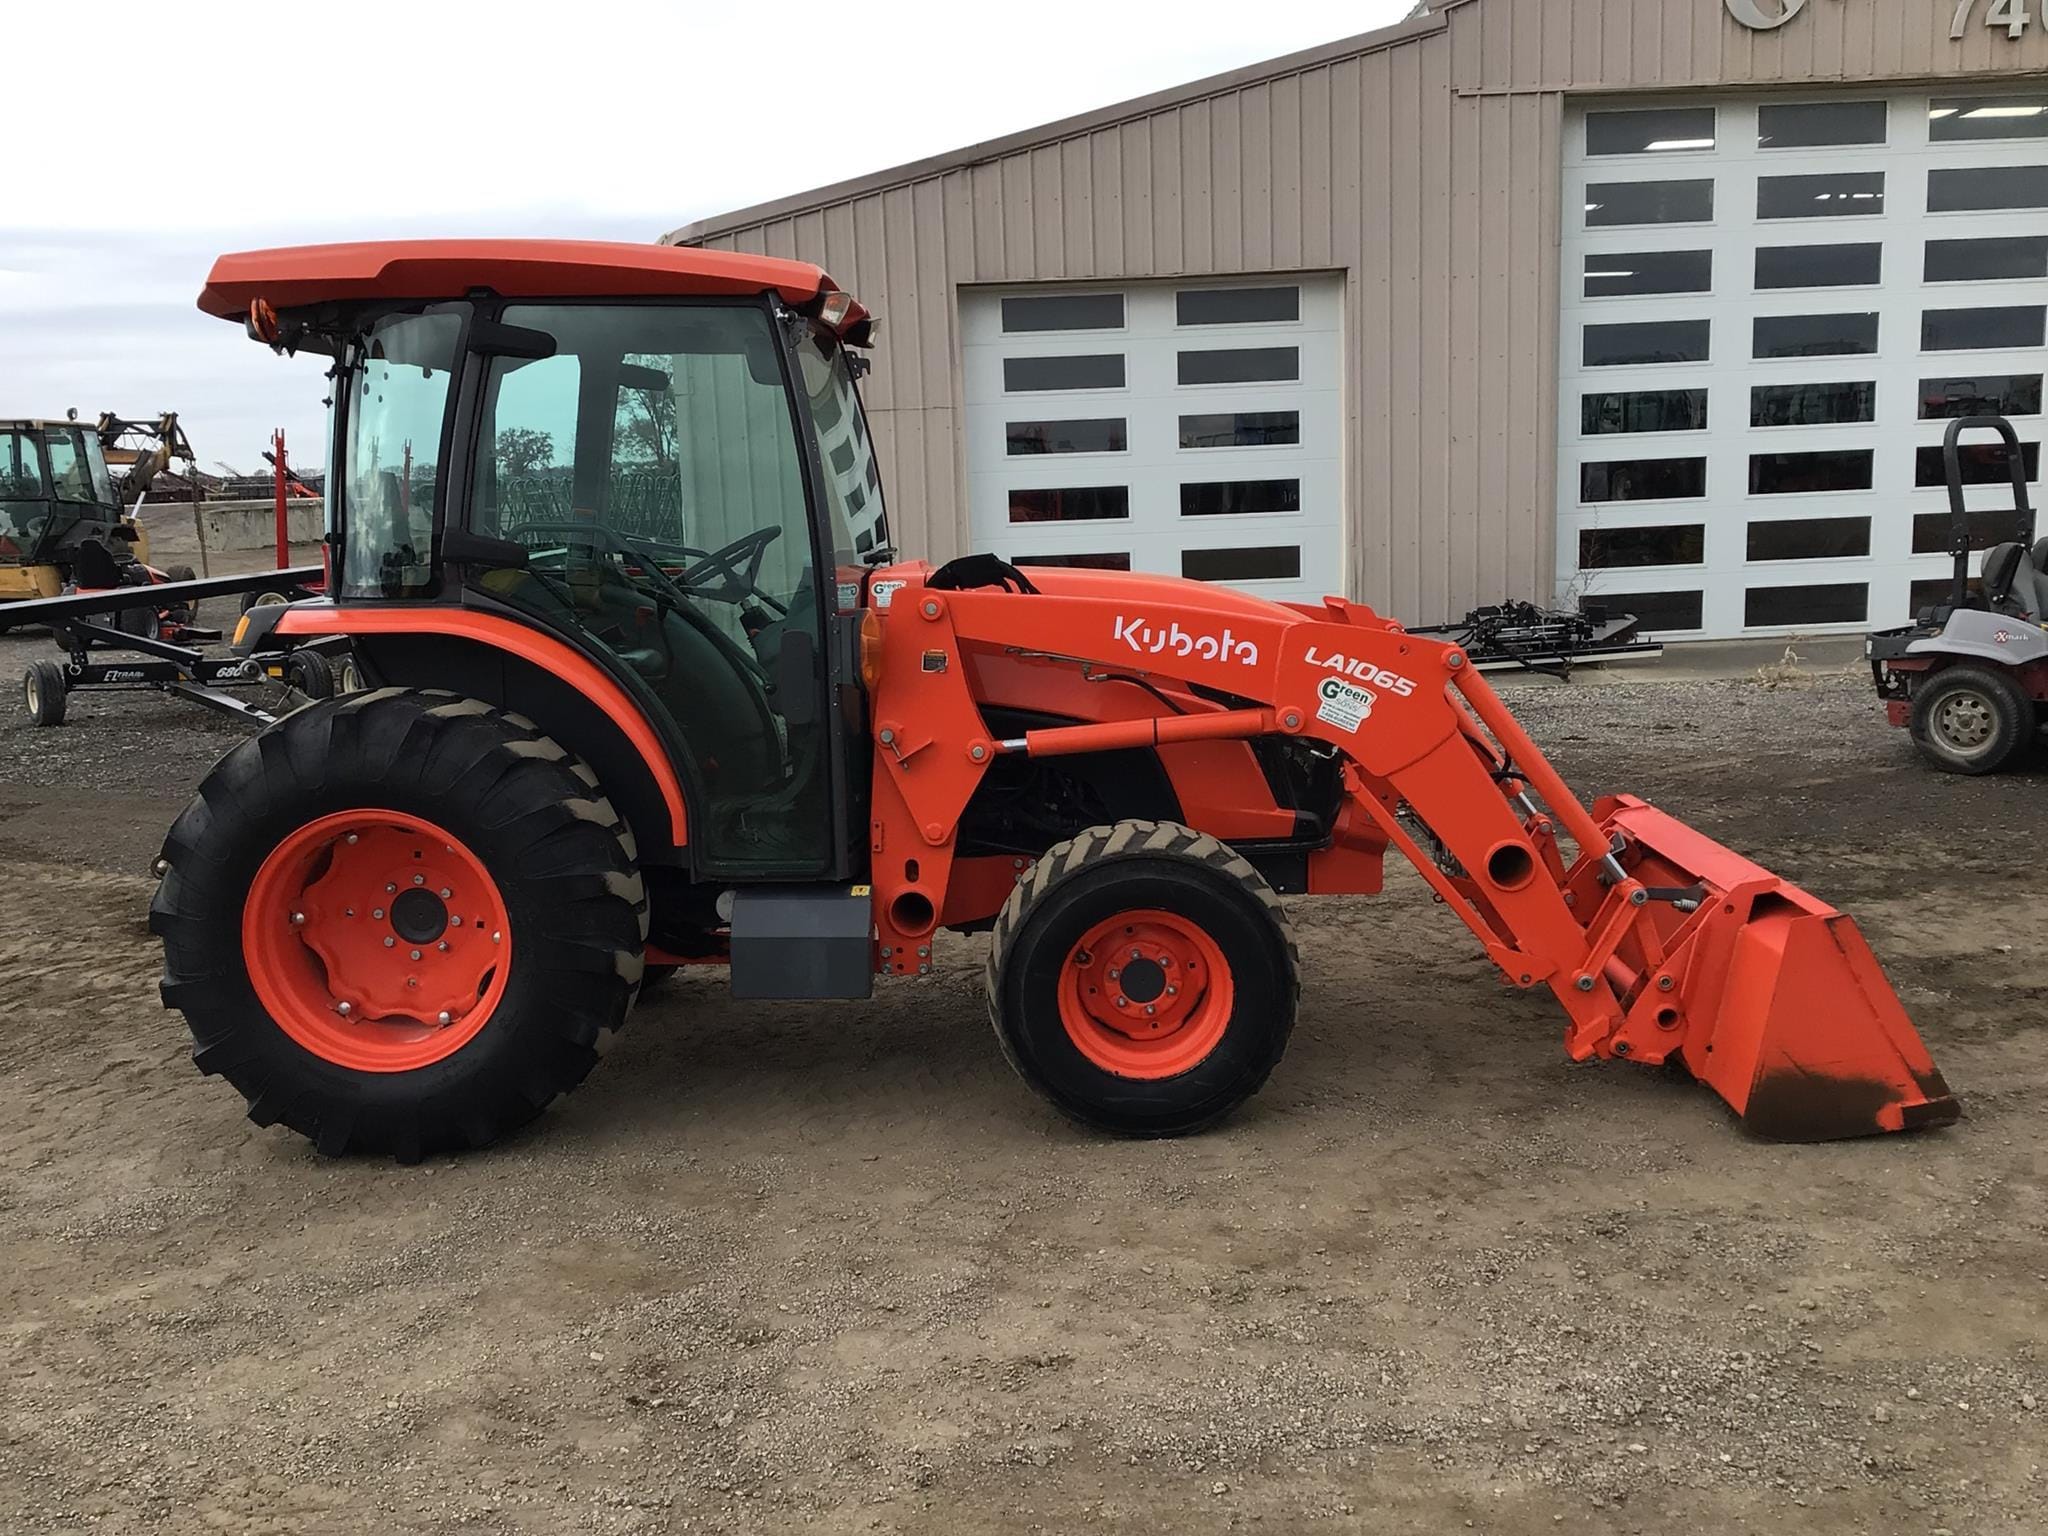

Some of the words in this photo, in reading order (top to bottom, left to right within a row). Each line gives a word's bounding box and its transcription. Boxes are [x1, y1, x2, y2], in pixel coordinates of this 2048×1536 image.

[1949, 0, 2048, 37] 74
[1114, 616, 1257, 666] Kubota
[1304, 646, 1418, 697] LA1065
[1322, 680, 1369, 704] Green
